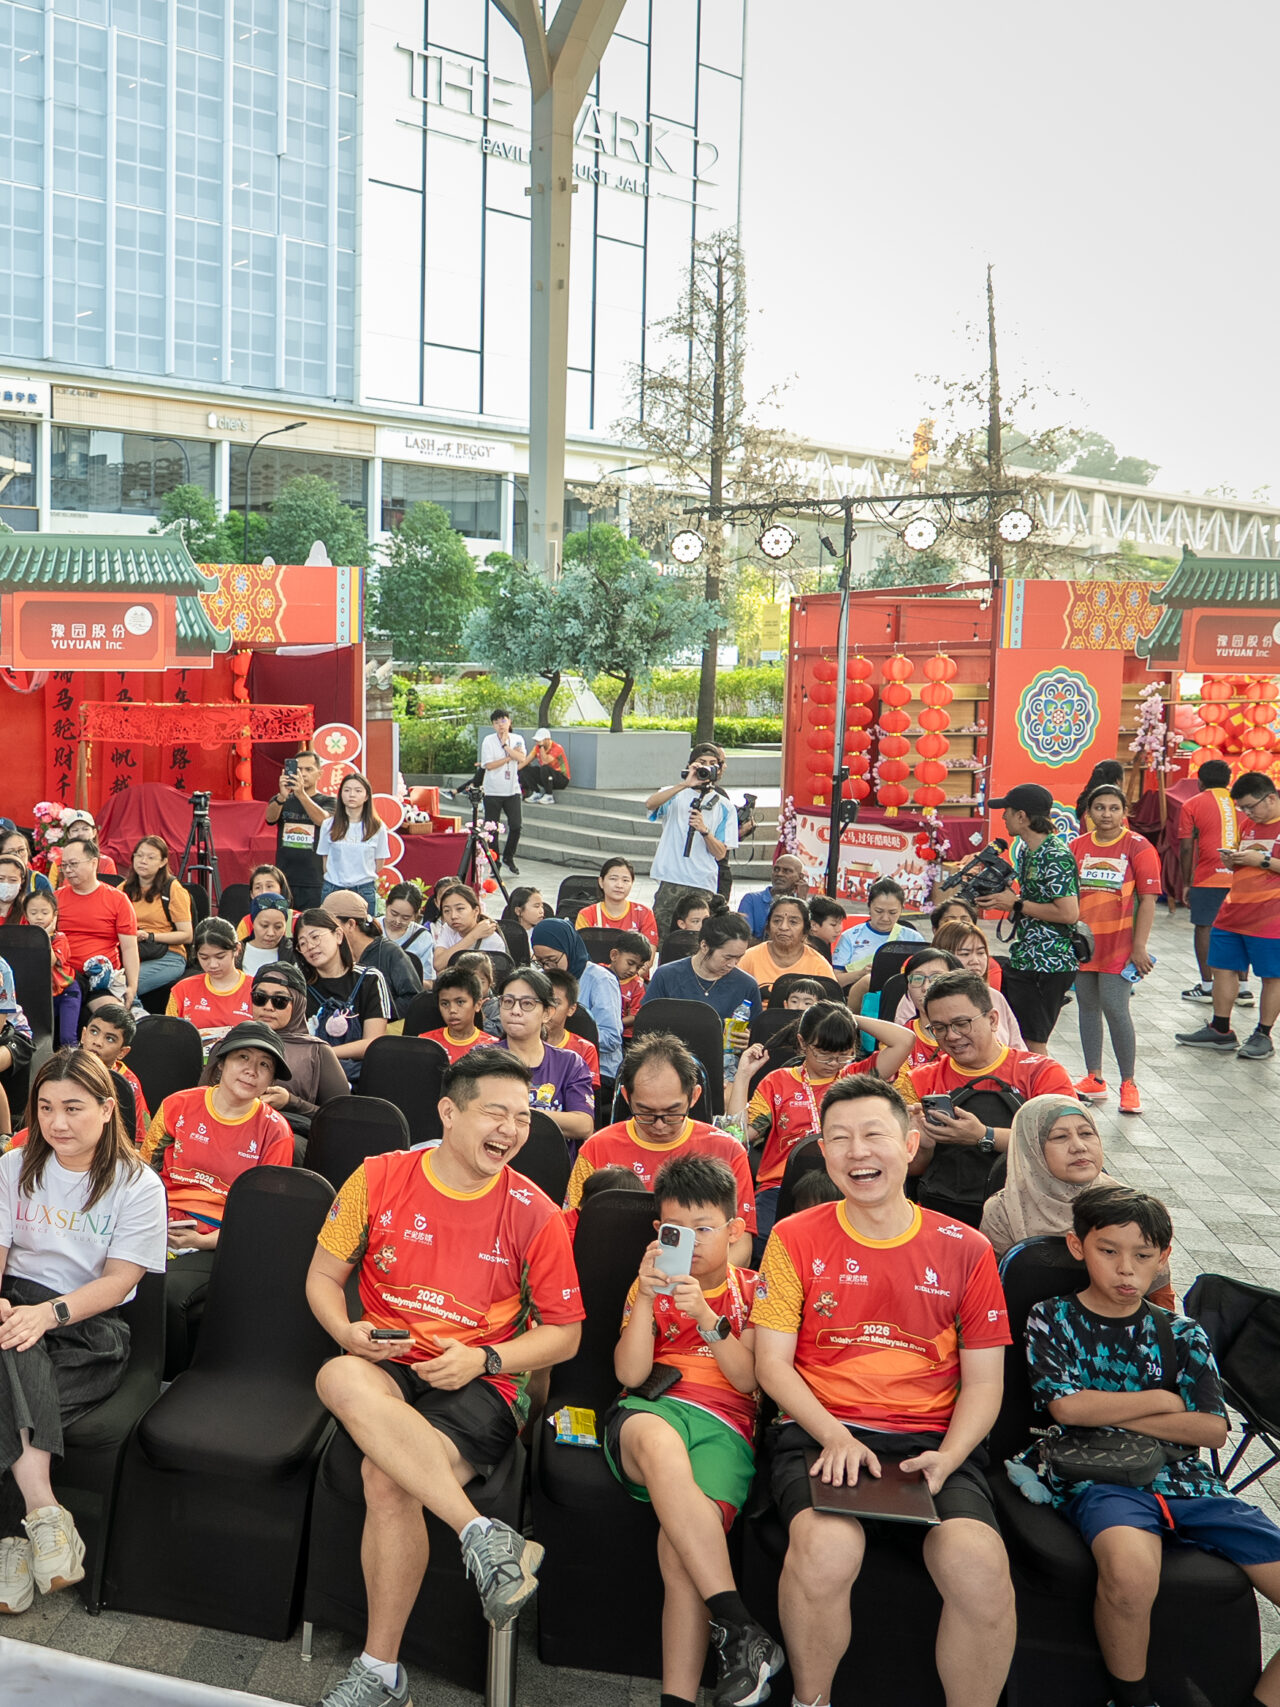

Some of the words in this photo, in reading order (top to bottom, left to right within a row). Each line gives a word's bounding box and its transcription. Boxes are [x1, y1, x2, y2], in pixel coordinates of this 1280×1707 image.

[394, 42, 531, 132] THE
[573, 103, 677, 174] ARK
[405, 436, 435, 450] LASH
[456, 443, 492, 458] PEGGY
[50, 623, 126, 638] 豫园股份
[51, 639, 101, 650] YUYUAN
[1216, 648, 1253, 657] YUYUAN
[16, 1200, 113, 1236] LUXSENZ
[416, 1289, 445, 1306] 2026
[382, 1292, 422, 1309] Kidslympic
[422, 1304, 462, 1321] Malaysia
[461, 1316, 478, 1328] Run
[863, 1324, 890, 1336] 2026
[871, 1335, 909, 1347] Malaysia
[909, 1344, 926, 1352] Run
